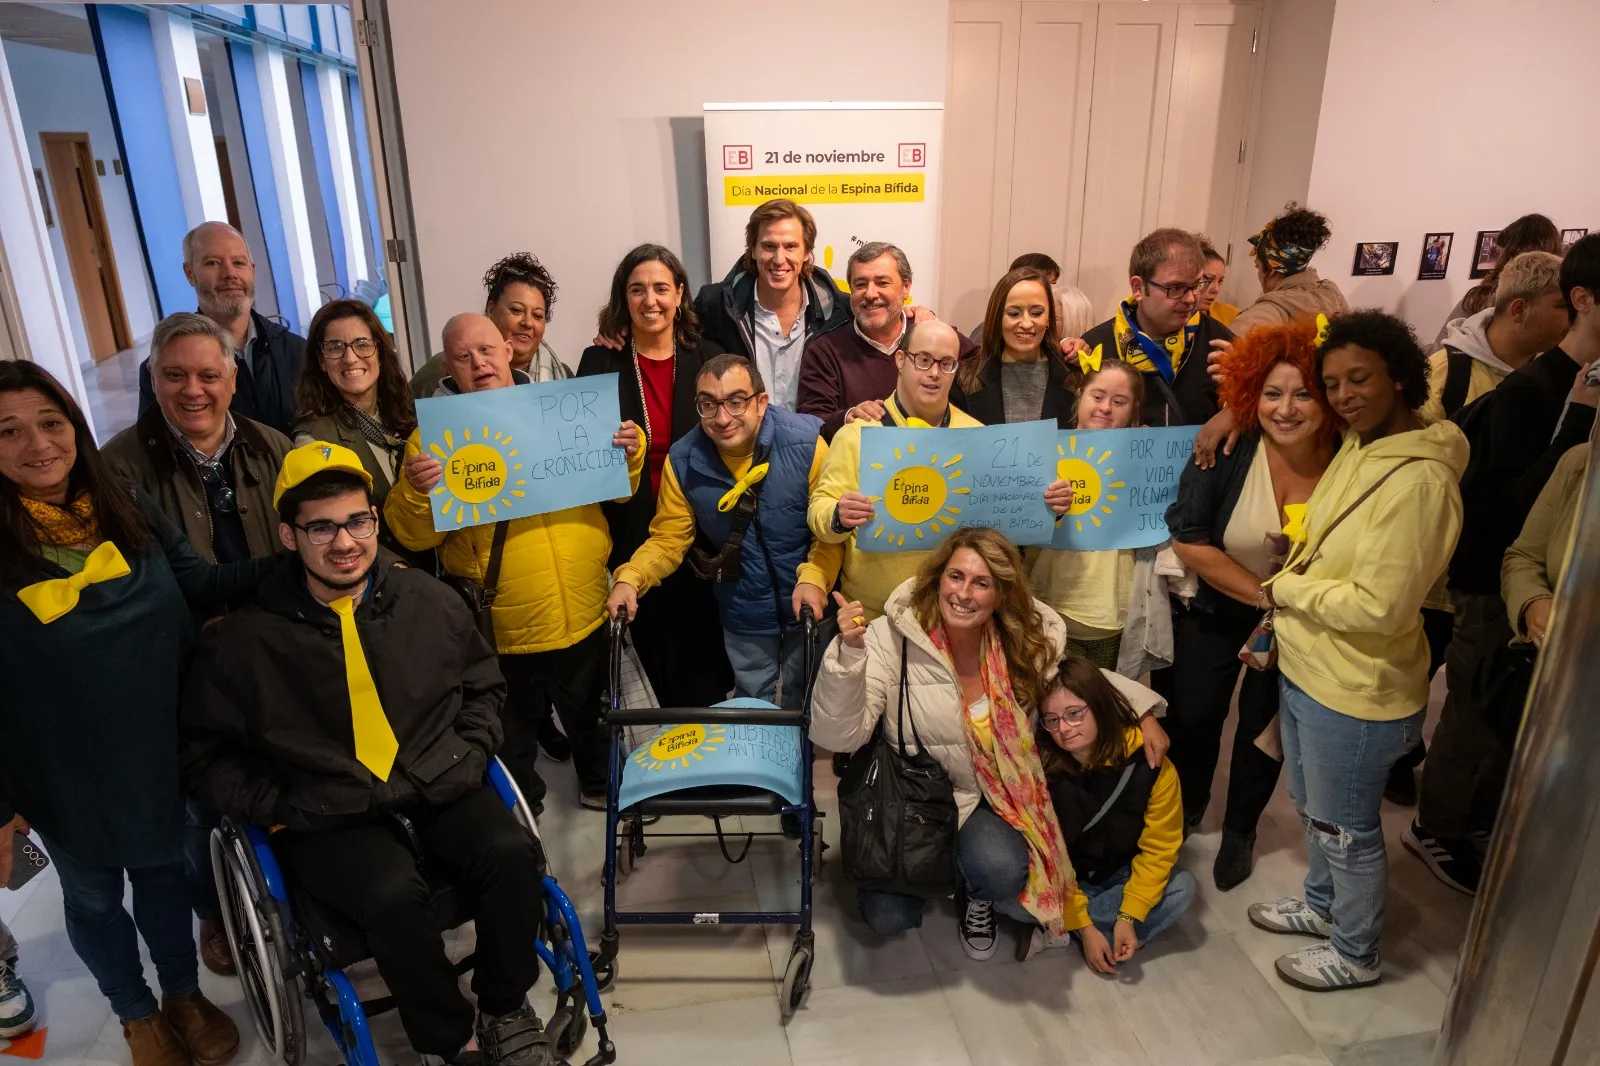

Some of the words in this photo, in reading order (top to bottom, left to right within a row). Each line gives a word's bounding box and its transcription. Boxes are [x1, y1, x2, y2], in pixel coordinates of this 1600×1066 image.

[765, 151, 779, 164] 21
[783, 150, 802, 164] de
[805, 149, 885, 163] noviembre
[732, 185, 751, 197] Día
[755, 184, 808, 196] Nacional
[810, 184, 826, 195] de
[828, 183, 838, 195] la
[841, 182, 881, 197] Espina
[884, 181, 919, 193] Bífida
[540, 390, 599, 426] POR
[557, 424, 590, 452] LA
[991, 436, 1019, 469] 21
[1027, 451, 1044, 468] DE
[1129, 438, 1156, 460] POR
[1166, 439, 1195, 460] UNA
[531, 448, 627, 480] CRONICIDAD
[1145, 465, 1174, 483] VIDA
[972, 473, 1045, 489] NOVIEMBRE
[993, 491, 1039, 503] NACIONAL
[1129, 486, 1169, 508] PLENA
[992, 505, 1006, 515] DE
[1010, 505, 1023, 514] LA
[1137, 512, 1166, 532] JUS
